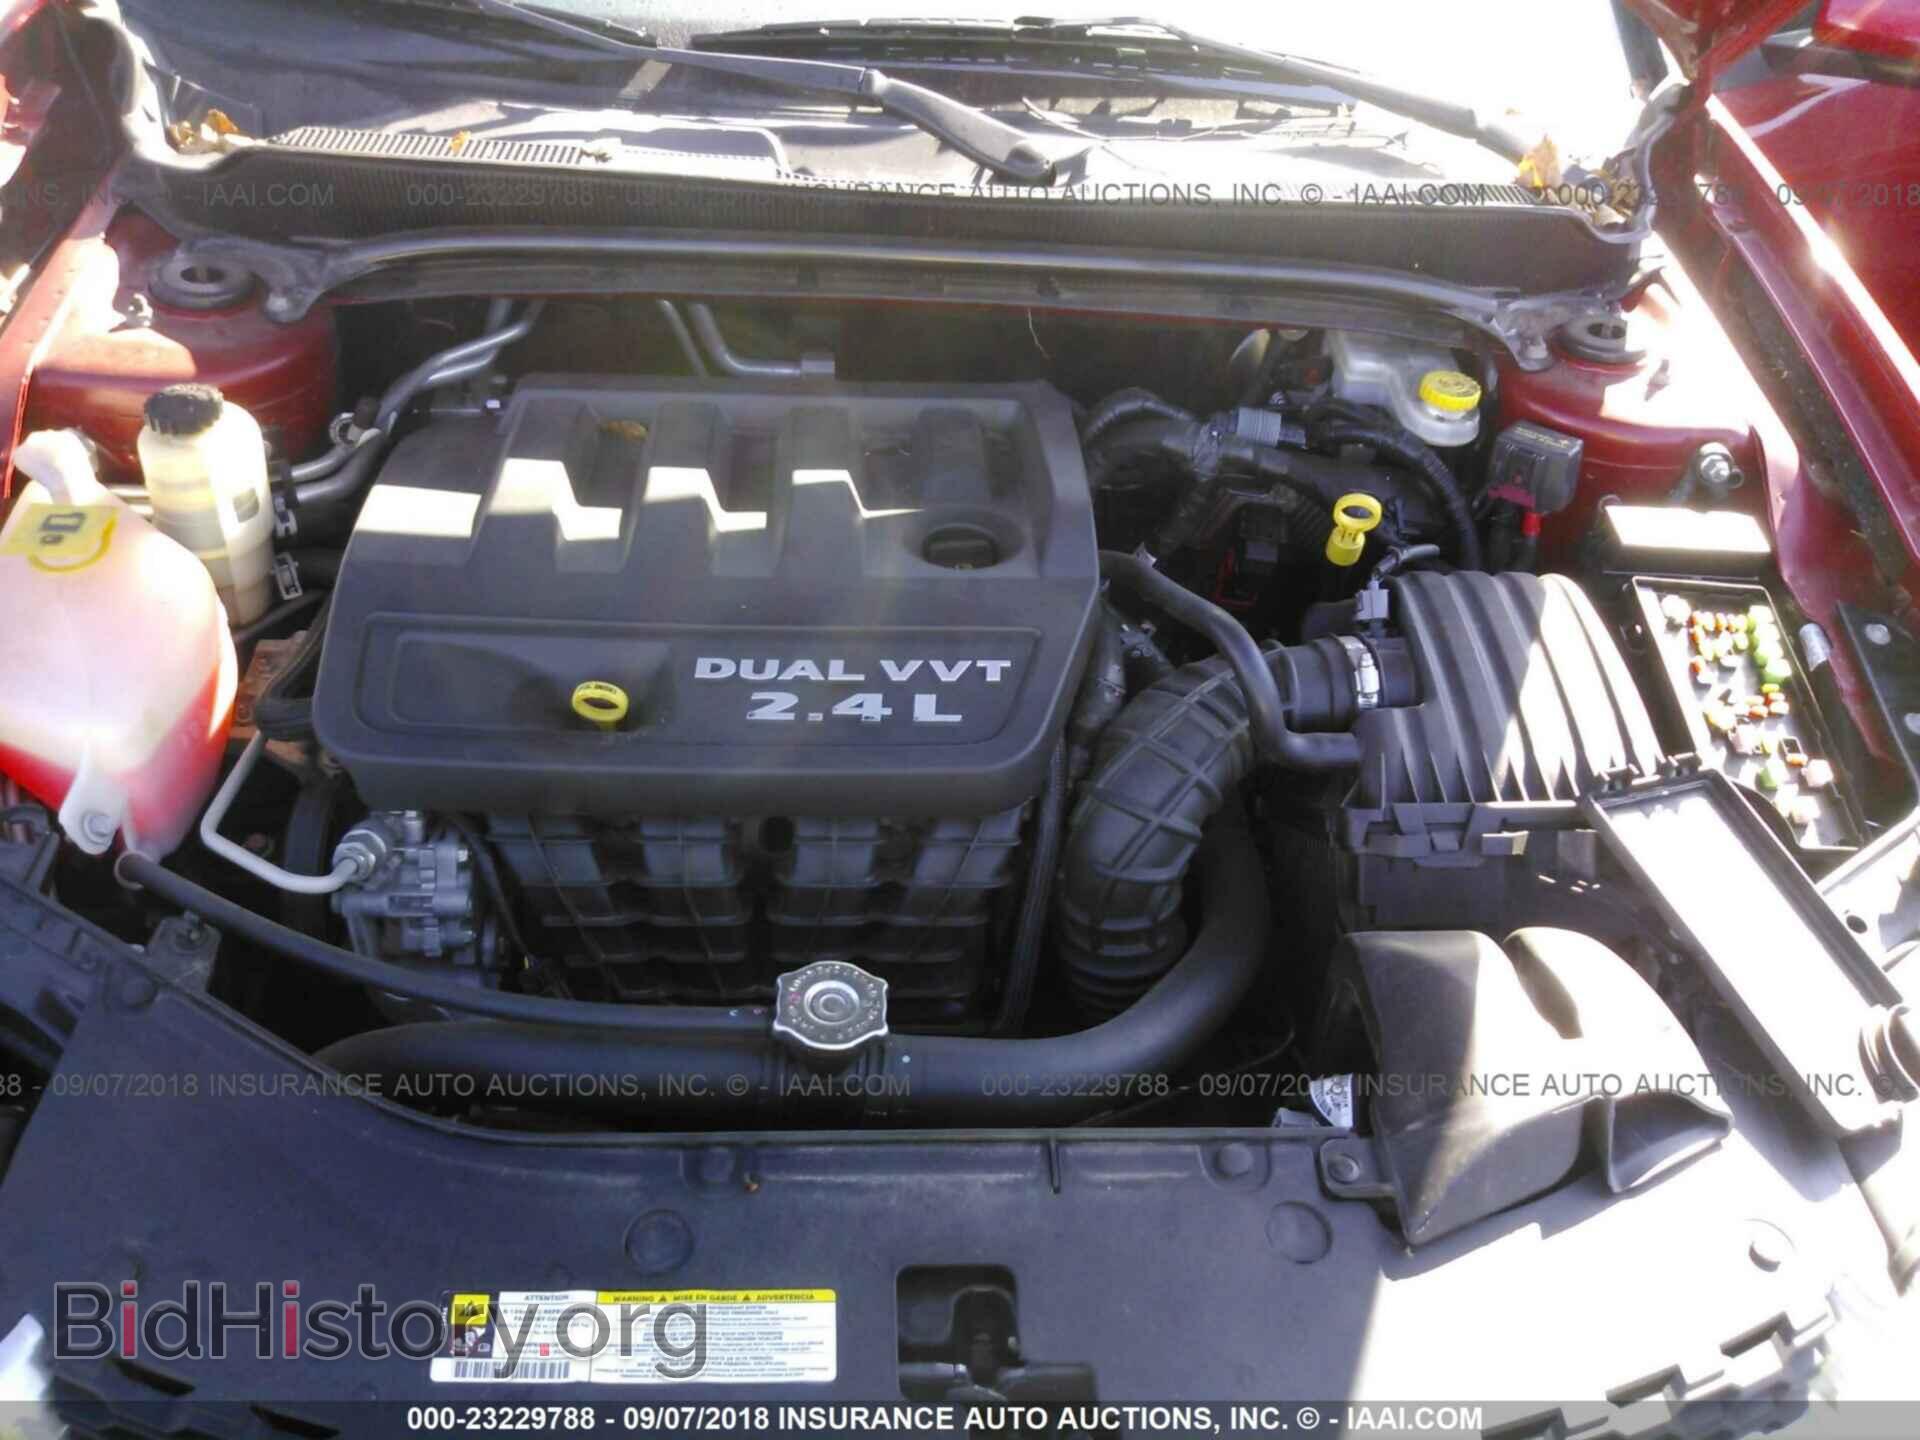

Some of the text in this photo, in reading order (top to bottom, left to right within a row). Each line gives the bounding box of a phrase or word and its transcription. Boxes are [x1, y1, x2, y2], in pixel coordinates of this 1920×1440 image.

[694, 657, 1011, 682] DUAL VVT
[613, 1295, 654, 1303] WARNING
